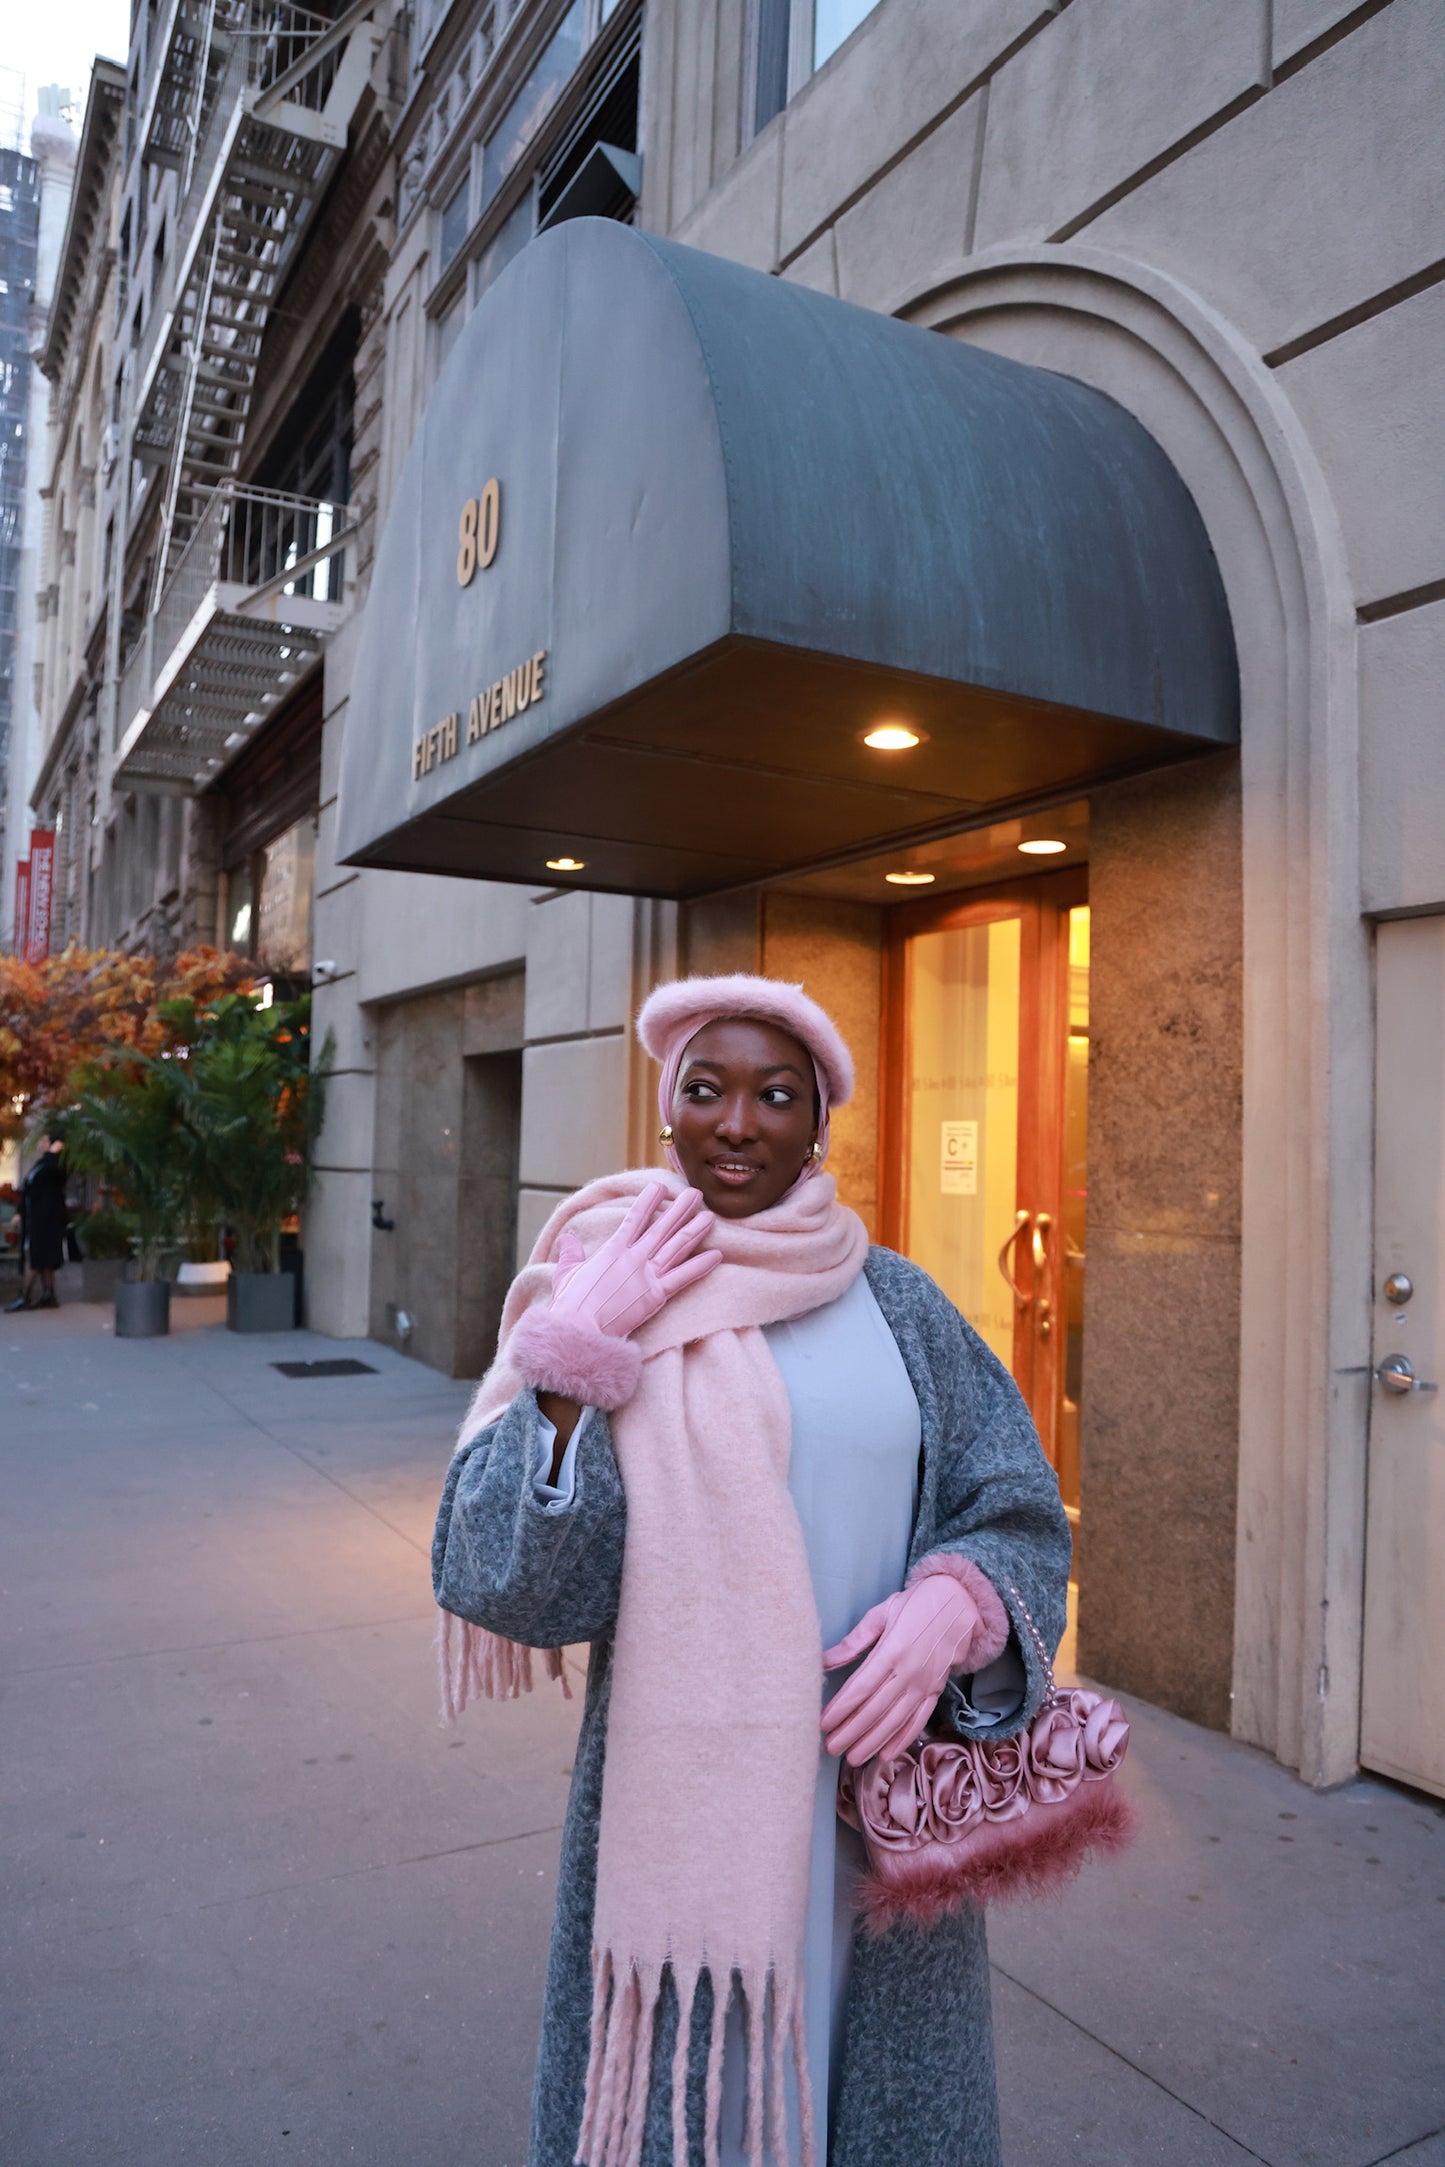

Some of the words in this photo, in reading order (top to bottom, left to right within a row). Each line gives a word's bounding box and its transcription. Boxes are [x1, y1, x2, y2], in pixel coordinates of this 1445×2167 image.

[457, 476, 499, 587] 80
[412, 711, 459, 781] FIFTH
[466, 649, 547, 745] AVENUE
[947, 1138, 958, 1156] C
